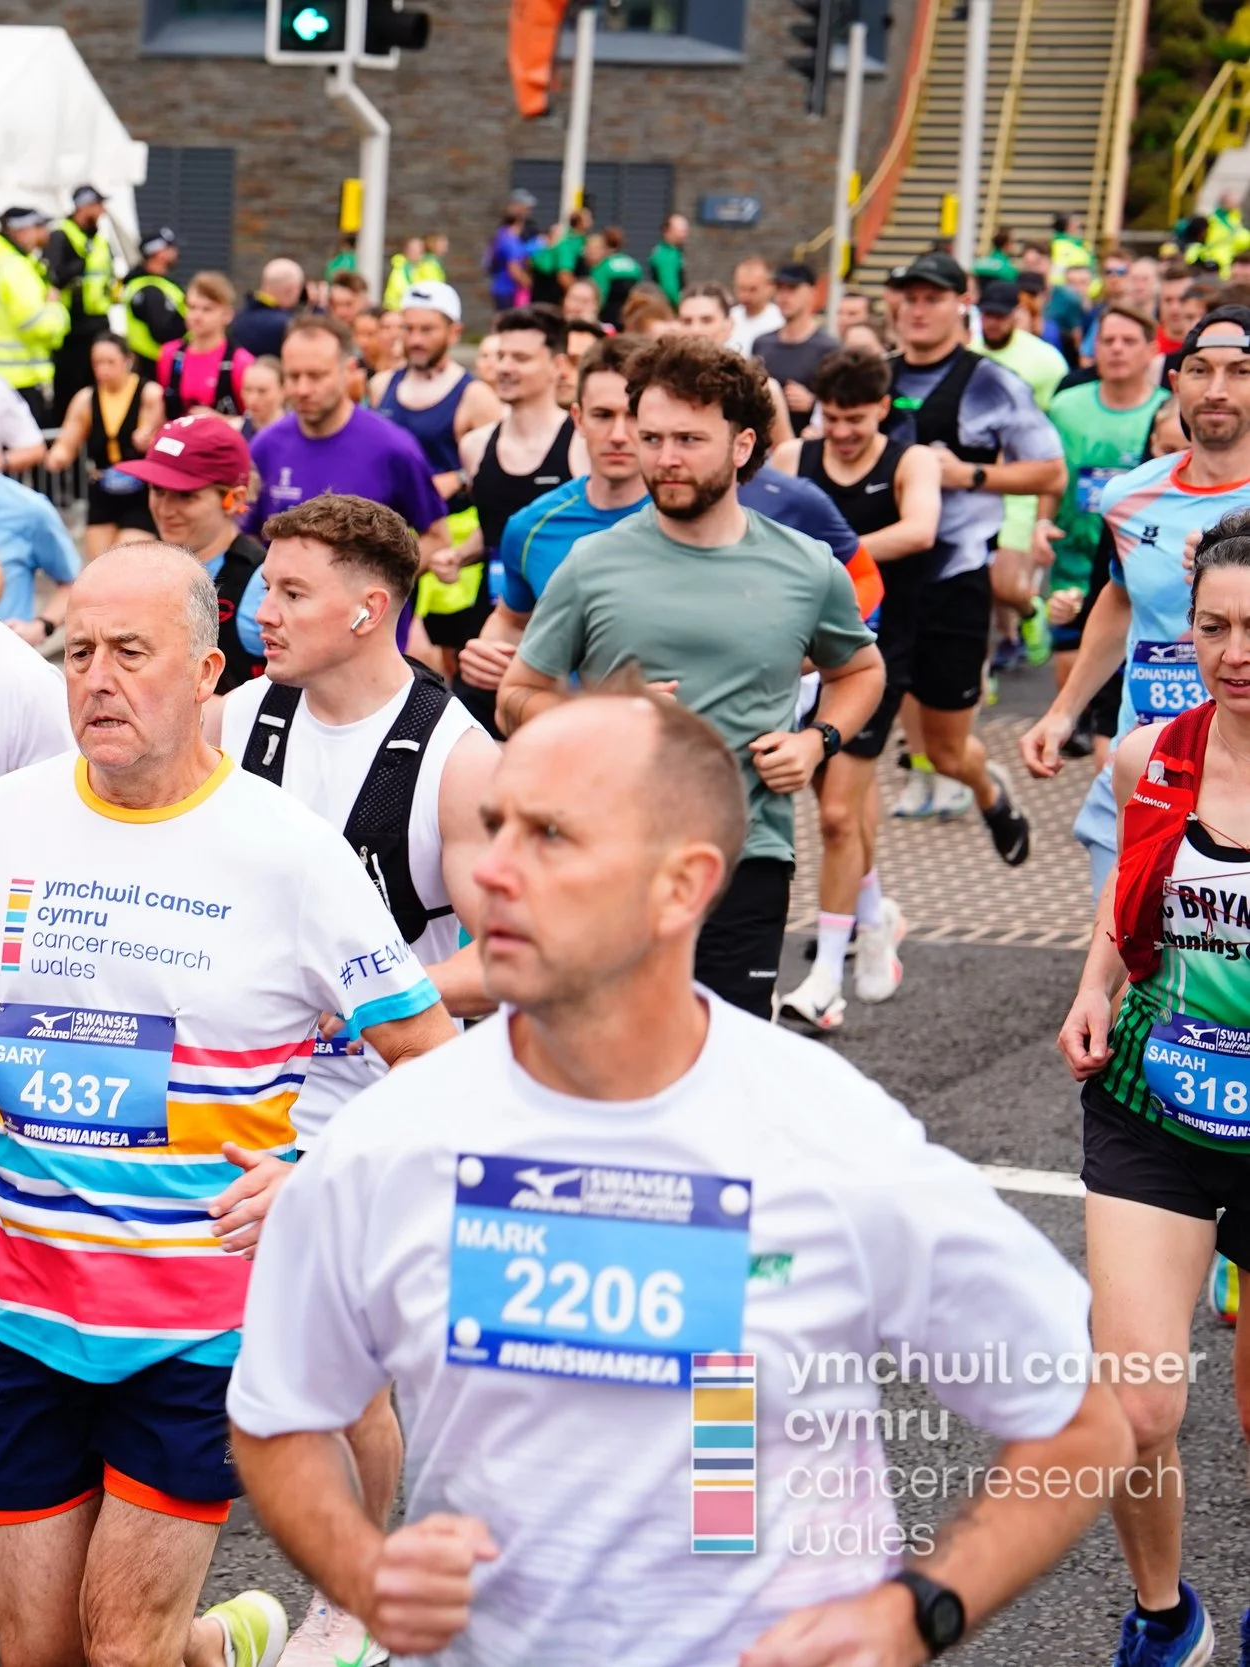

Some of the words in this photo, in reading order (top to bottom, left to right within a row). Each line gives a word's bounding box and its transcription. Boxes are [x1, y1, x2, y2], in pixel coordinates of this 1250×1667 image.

[1131, 667, 1197, 681] JONATHAN
[1150, 682, 1213, 710] 833
[1133, 792, 1171, 810] SALOMON
[43, 880, 141, 905] ymchwil
[145, 891, 232, 920] canser
[37, 906, 109, 927] cymru
[32, 931, 109, 953] cancer
[111, 939, 211, 971] research
[31, 957, 96, 980] wales
[75, 1012, 138, 1030] SWANSEA
[1148, 1045, 1205, 1072] SARAH
[20, 1070, 130, 1118] 4337
[1174, 1071, 1248, 1115] 318
[24, 1123, 130, 1147] #RUNSWANSEA
[1178, 1112, 1250, 1137] #RUNSWAN
[590, 1168, 694, 1199] SWANSEA
[456, 1218, 548, 1255] MARK
[501, 1257, 685, 1339] 2206
[498, 1342, 681, 1385] #RUNSWANSEA
